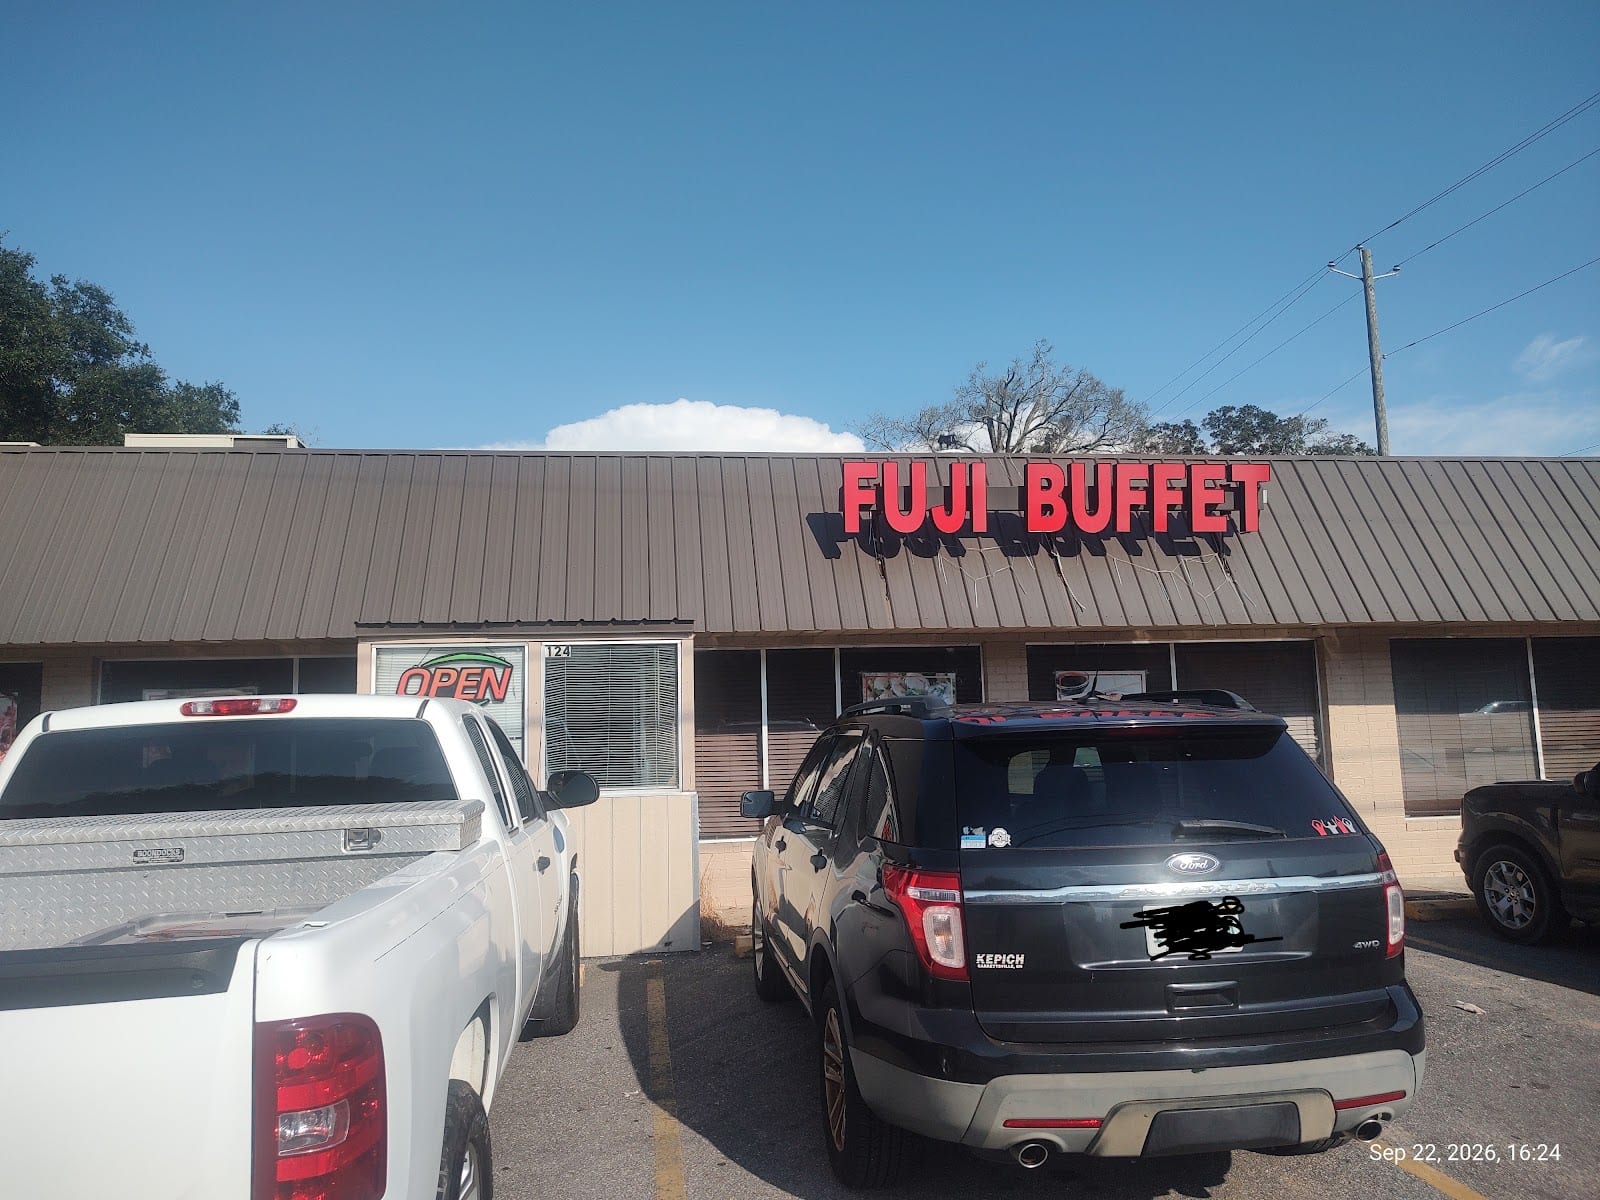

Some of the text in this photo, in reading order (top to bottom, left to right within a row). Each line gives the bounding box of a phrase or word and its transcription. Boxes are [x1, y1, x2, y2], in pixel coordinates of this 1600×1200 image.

[843, 461, 1271, 534] FUJI BUFFET
[547, 645, 570, 657] 124
[397, 667, 513, 704] OPEN
[1180, 855, 1209, 870] Ford
[1353, 940, 1380, 949] 4WD
[976, 954, 1025, 964] KEPICH
